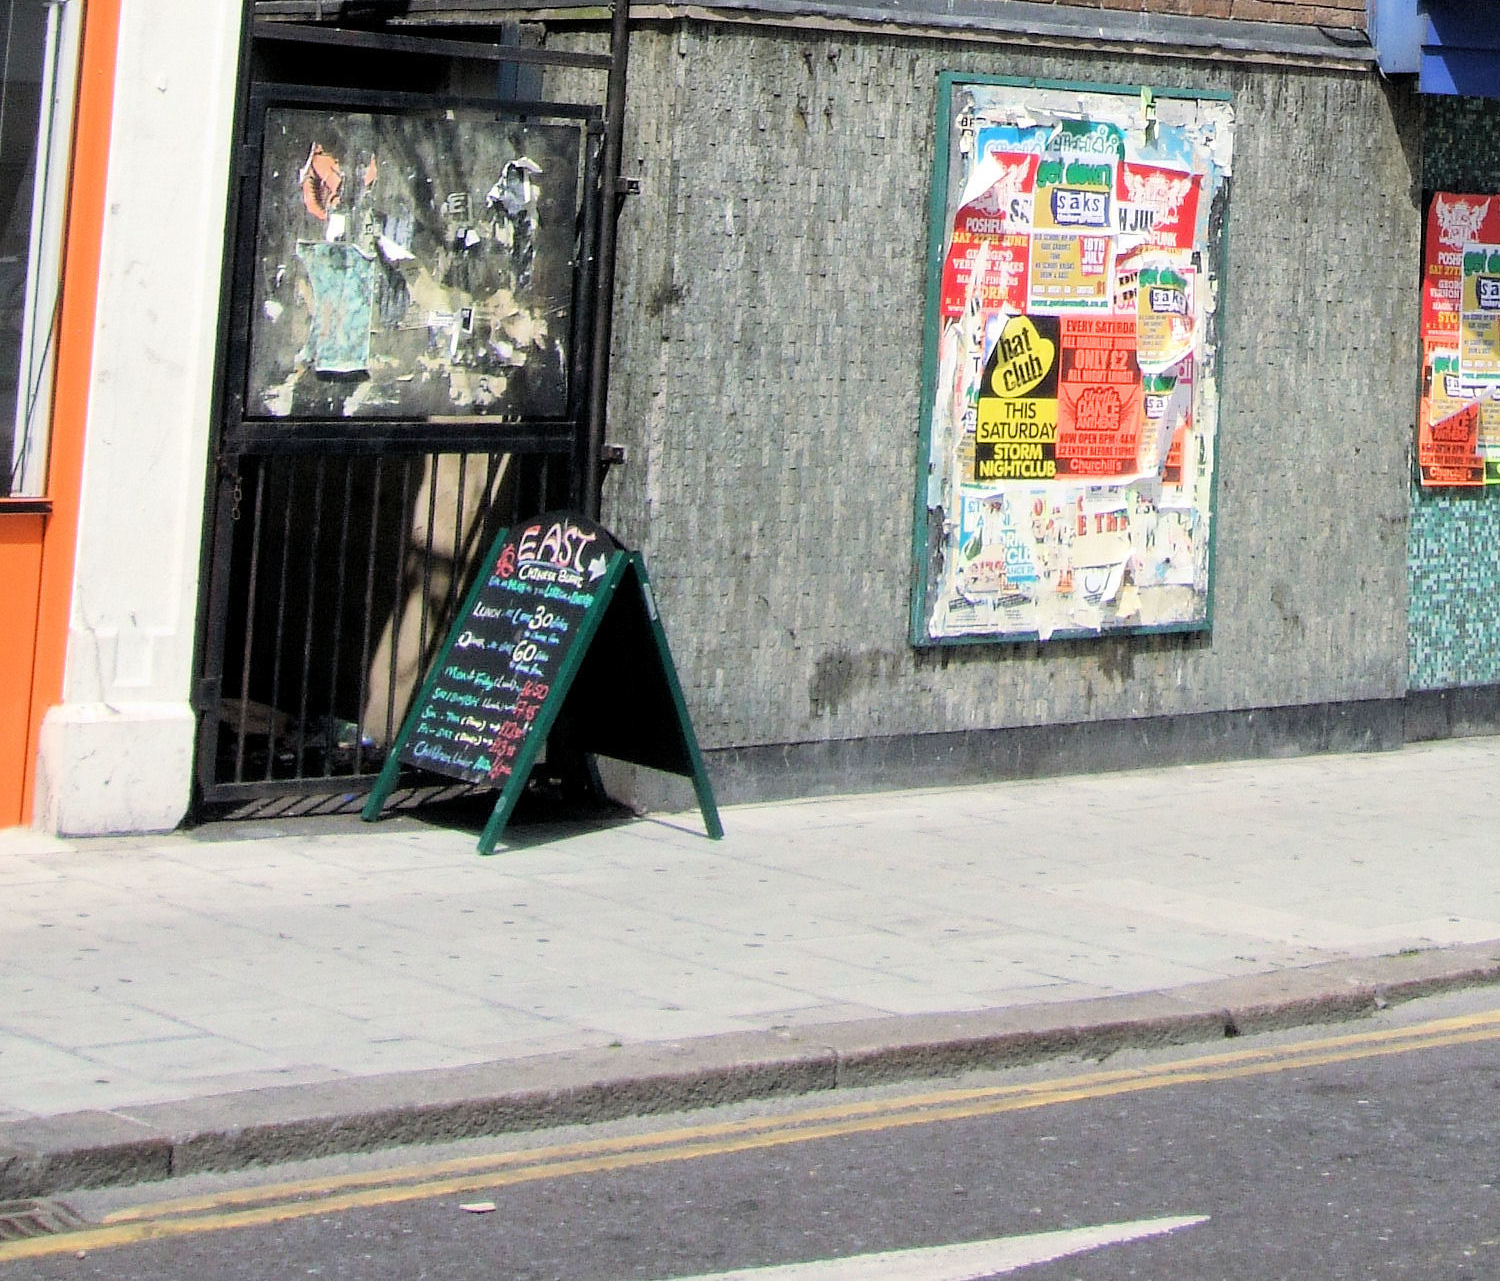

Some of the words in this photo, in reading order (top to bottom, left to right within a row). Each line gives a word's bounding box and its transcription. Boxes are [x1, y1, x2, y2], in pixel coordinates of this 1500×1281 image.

[1057, 193, 1101, 213] saks
[1066, 320, 1094, 332] EVERY
[1095, 320, 1136, 334] SATURDA
[1438, 312, 1459, 323] STO
[999, 327, 1032, 363] hat
[1074, 348, 1109, 369] ONLY
[1110, 350, 1128, 369] £2
[1002, 353, 1043, 392] club
[1004, 402, 1036, 419] THIS
[1077, 398, 1121, 416] DANCE
[980, 421, 1057, 440] SATURDAY
[993, 443, 1043, 460] STORM
[979, 460, 1057, 478] NIGHTCLUB
[517, 523, 596, 572] EAST
[528, 605, 554, 630] 30
[512, 639, 537, 663] 60
